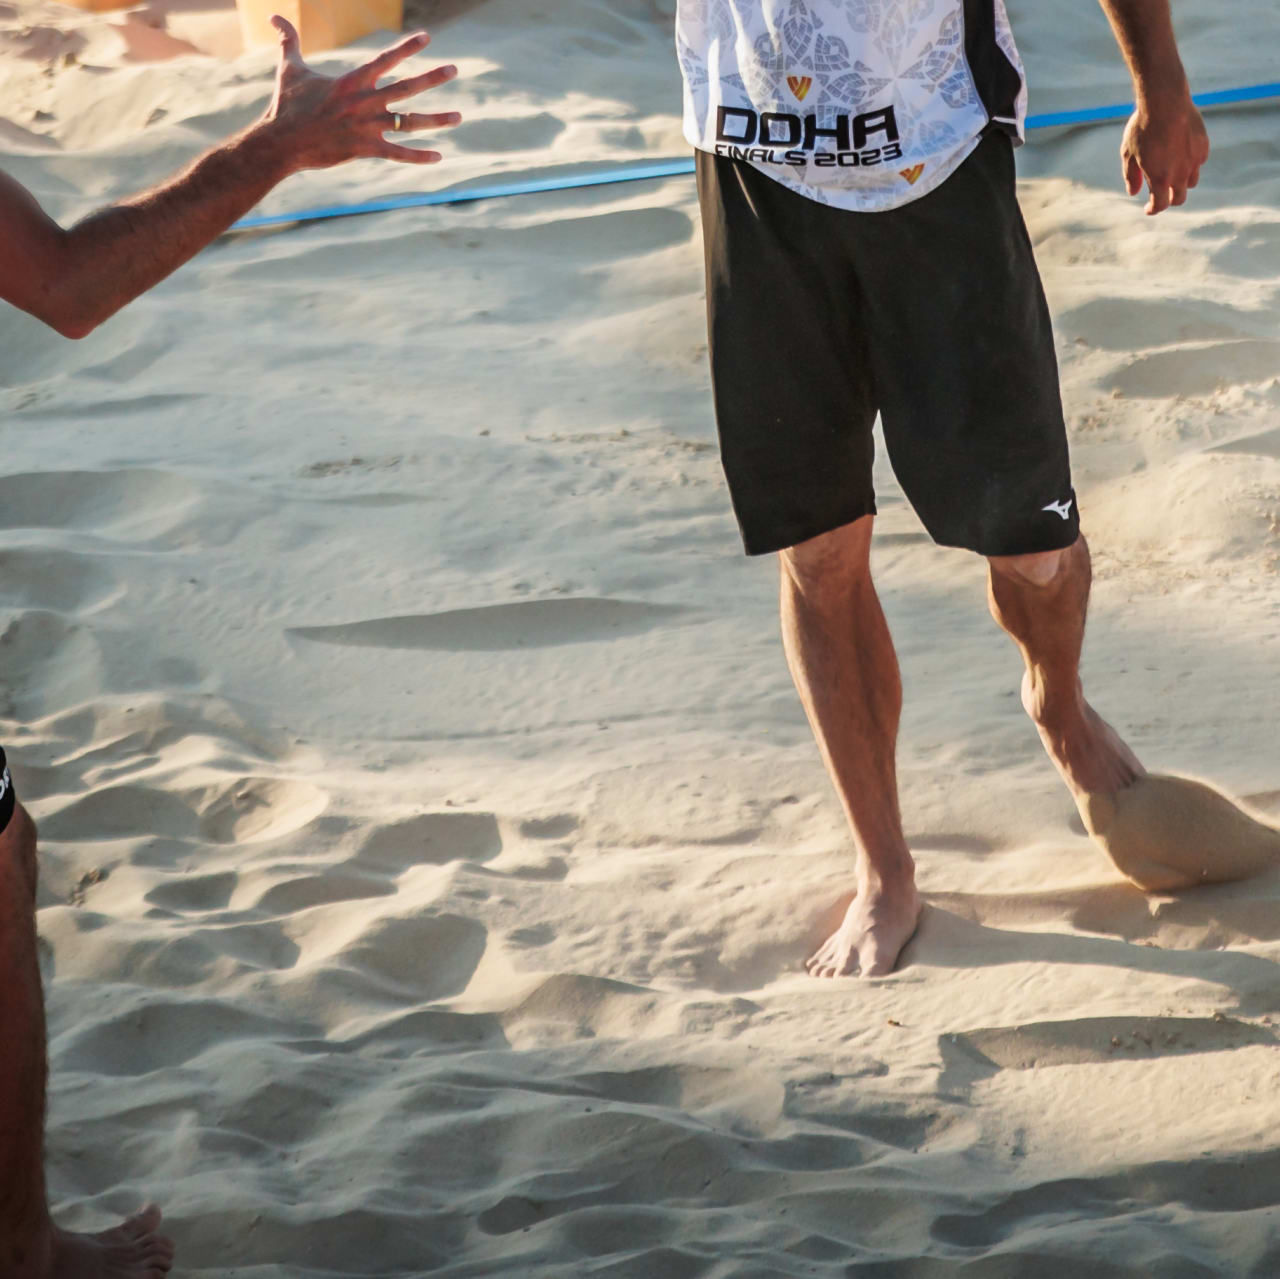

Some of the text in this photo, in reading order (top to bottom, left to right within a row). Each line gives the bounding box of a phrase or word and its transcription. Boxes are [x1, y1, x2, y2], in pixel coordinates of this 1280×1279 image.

[715, 104, 901, 152] DOHA
[714, 141, 904, 168] FINALS 2023
